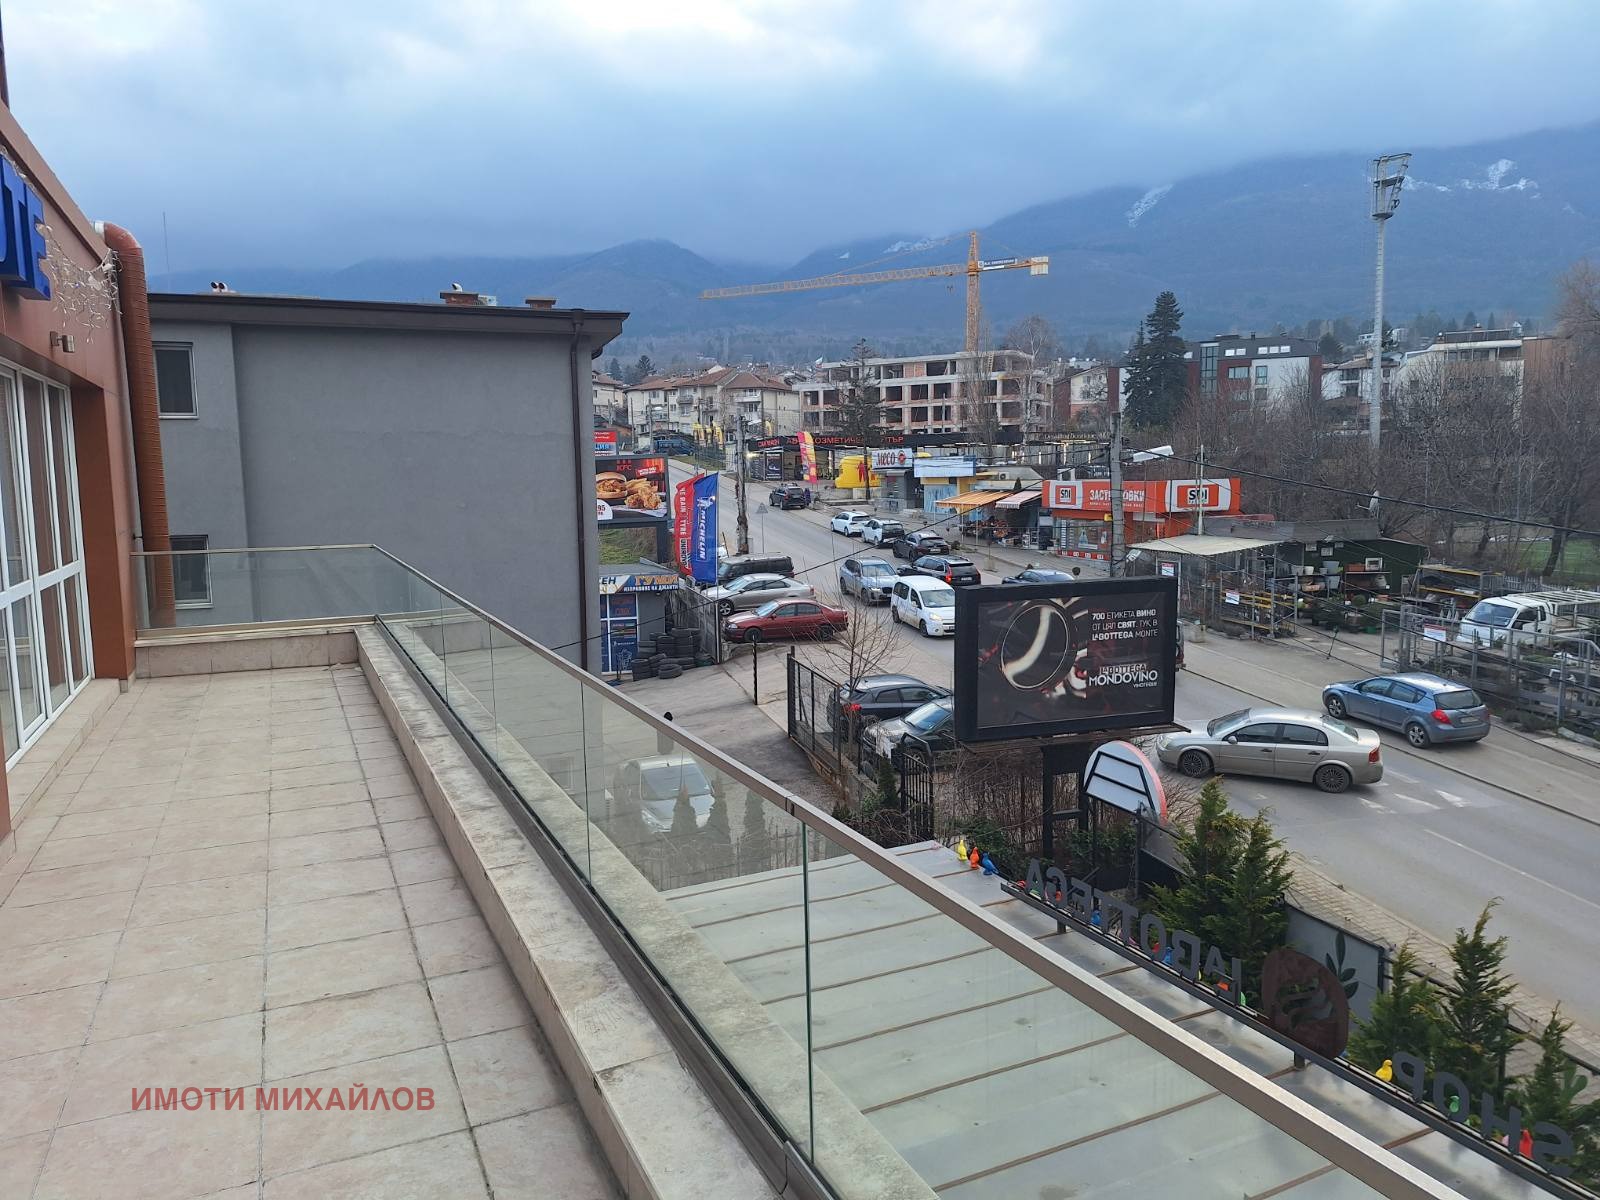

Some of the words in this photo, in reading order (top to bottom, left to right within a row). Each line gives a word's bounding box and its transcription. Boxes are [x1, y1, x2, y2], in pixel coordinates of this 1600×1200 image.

[0, 155, 51, 300] TE
[1060, 488, 1071, 499] SDI
[1089, 489, 1145, 502] ЗАСТОВКИ
[679, 496, 687, 513] RAIN
[679, 519, 687, 536] TYRE
[1092, 612, 1105, 620] 700
[1106, 610, 1136, 619] ЕТИКЕТА
[1136, 609, 1156, 617] ВИНО
[1092, 623, 1100, 631] ОТ
[1102, 622, 1116, 631] ЦЯЛ
[1134, 629, 1159, 638] MONTE
[1088, 670, 1158, 687] MONDOVINO
